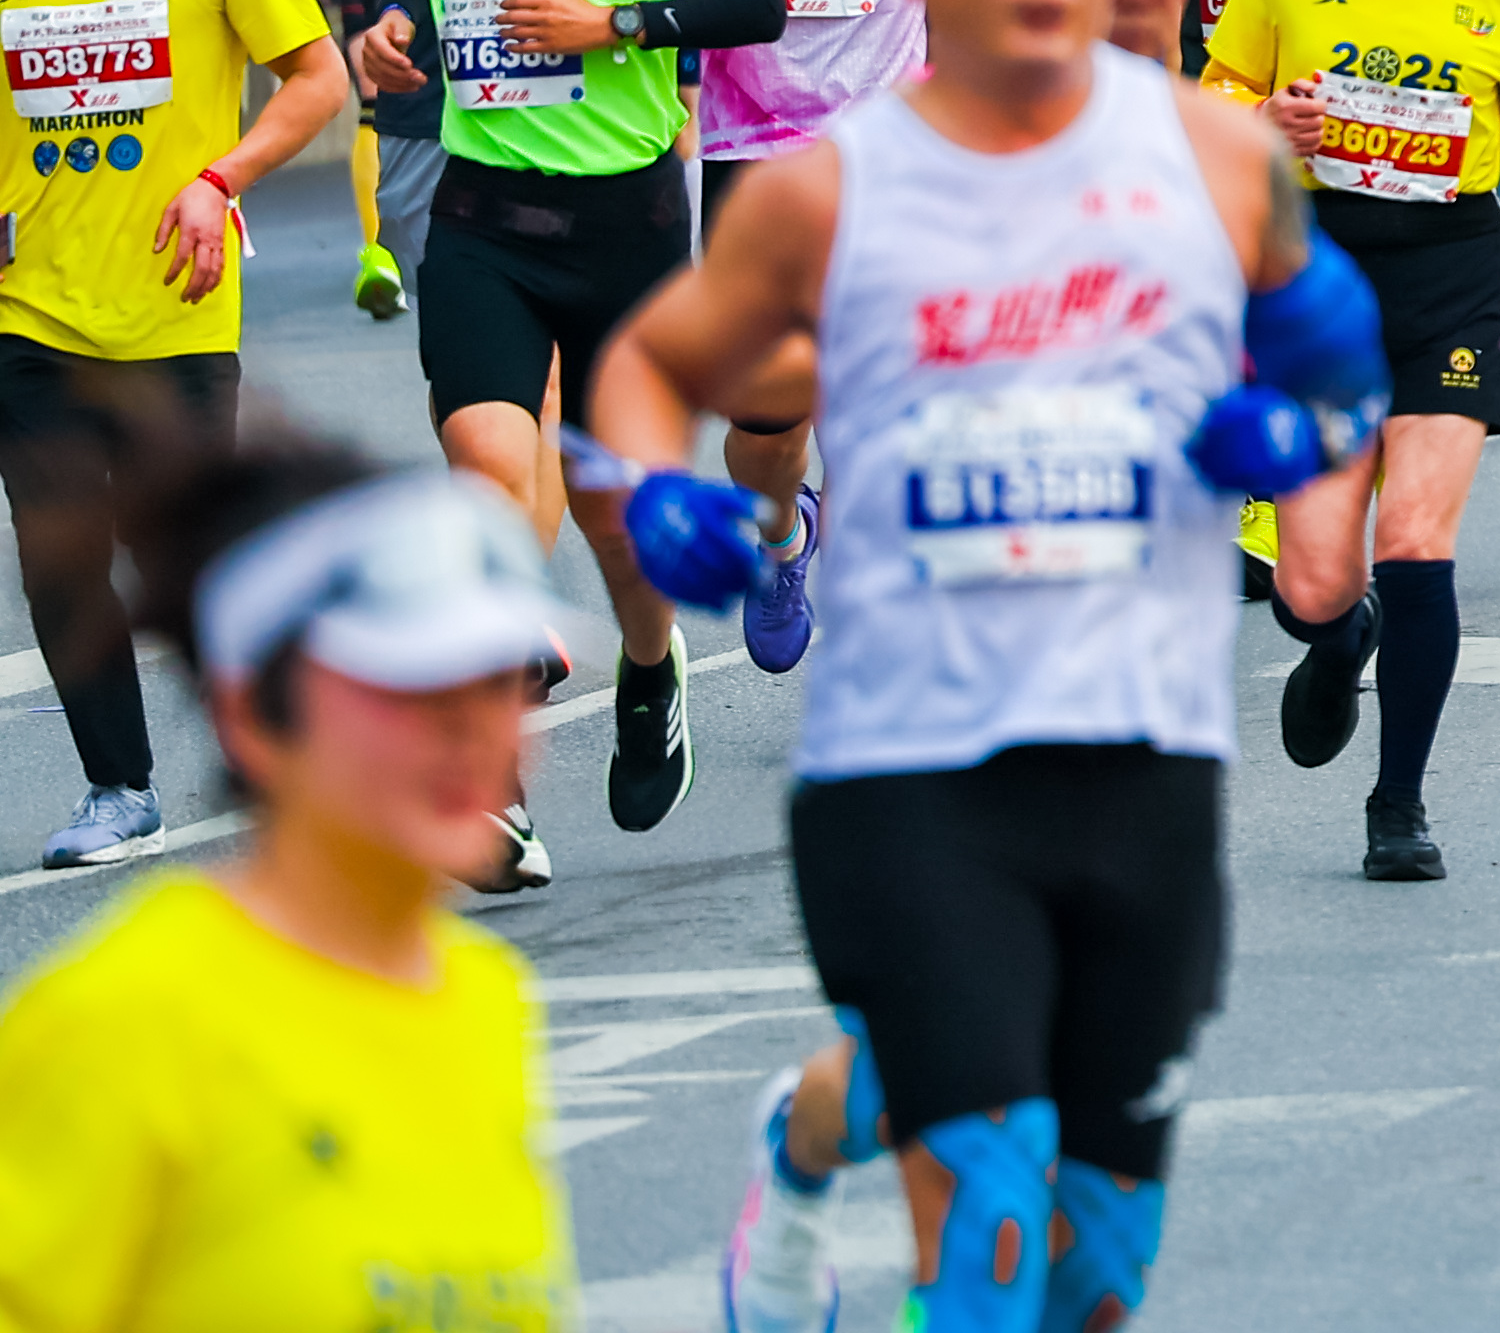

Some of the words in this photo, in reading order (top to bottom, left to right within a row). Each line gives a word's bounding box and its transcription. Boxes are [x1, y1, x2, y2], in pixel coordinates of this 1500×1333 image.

[20, 40, 154, 81] D38773
[1329, 41, 1463, 93] 2025
[29, 108, 145, 133] MARATHON
[1322, 117, 1452, 168] B60723
